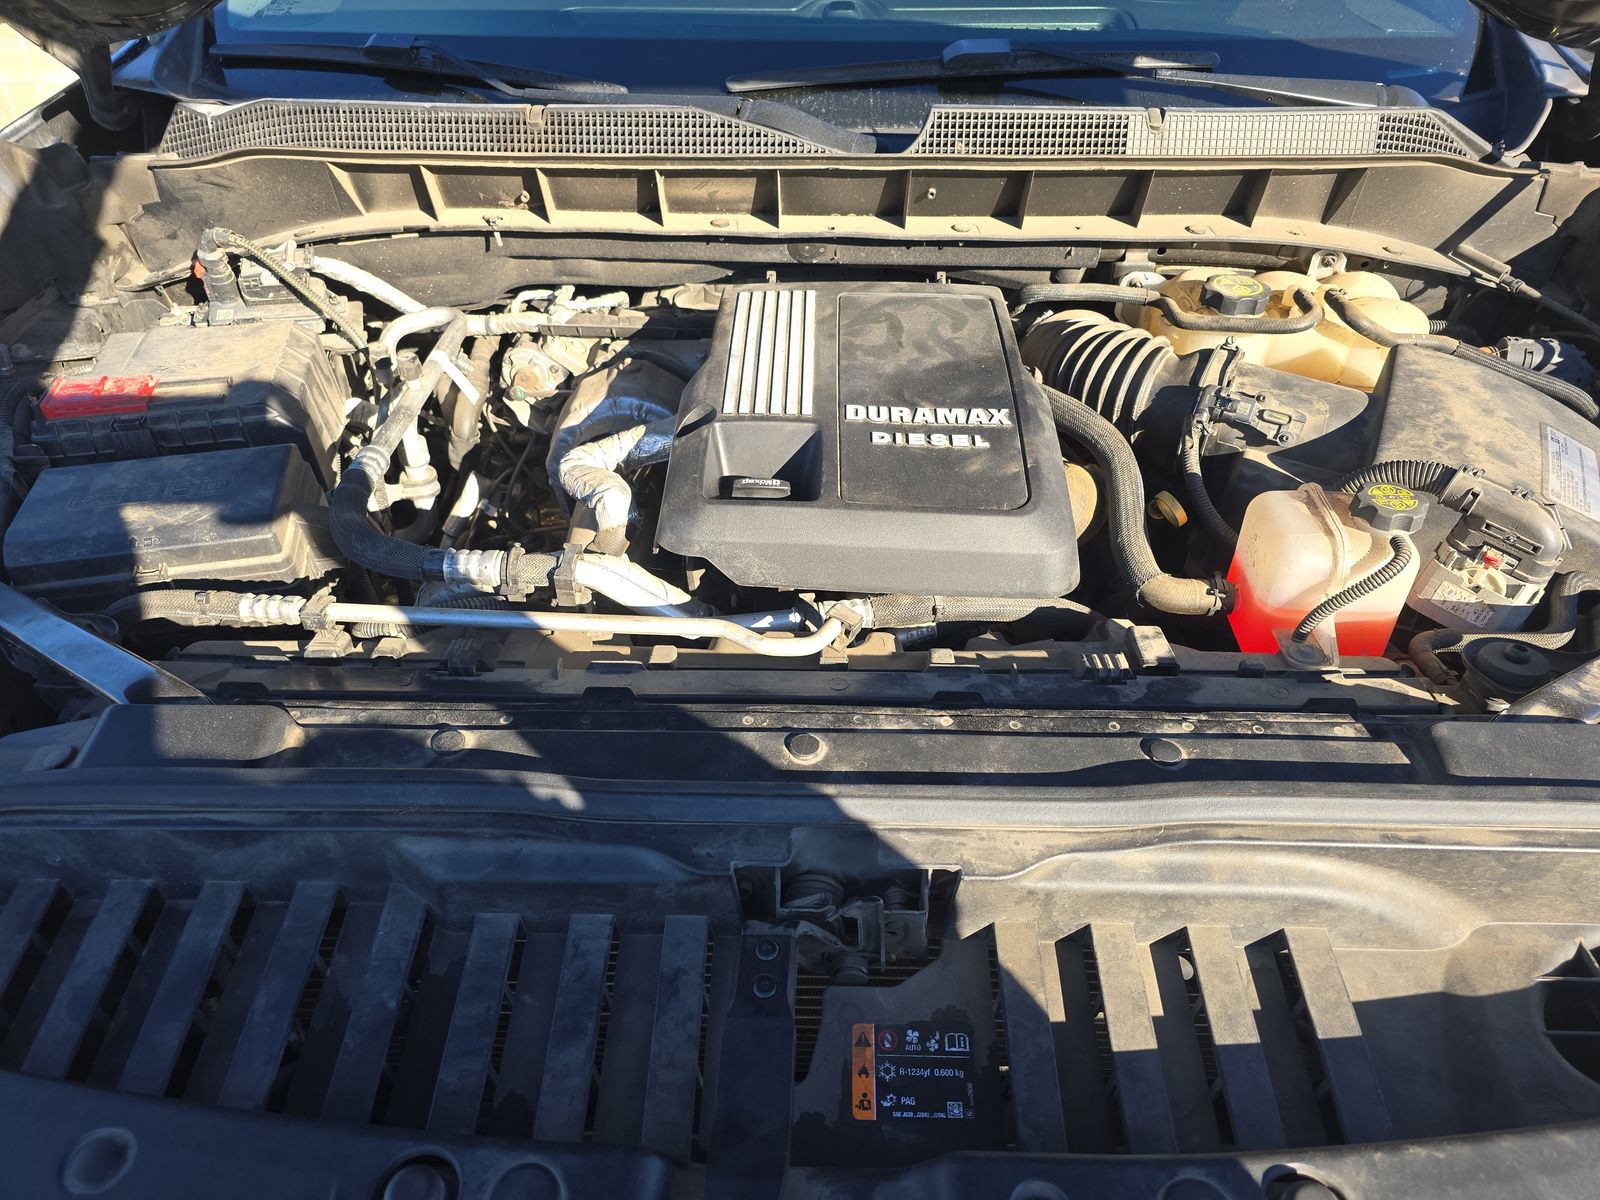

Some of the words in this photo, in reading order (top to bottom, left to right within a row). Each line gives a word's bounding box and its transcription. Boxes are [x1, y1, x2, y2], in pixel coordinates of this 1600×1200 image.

[844, 404, 1013, 426] DURAMAX
[870, 431, 991, 449] DIESEL
[899, 1068, 931, 1078] R-1234yf
[934, 1068, 954, 1077] 0.600
[955, 1069, 964, 1078] kg
[901, 1097, 916, 1106] PAG
